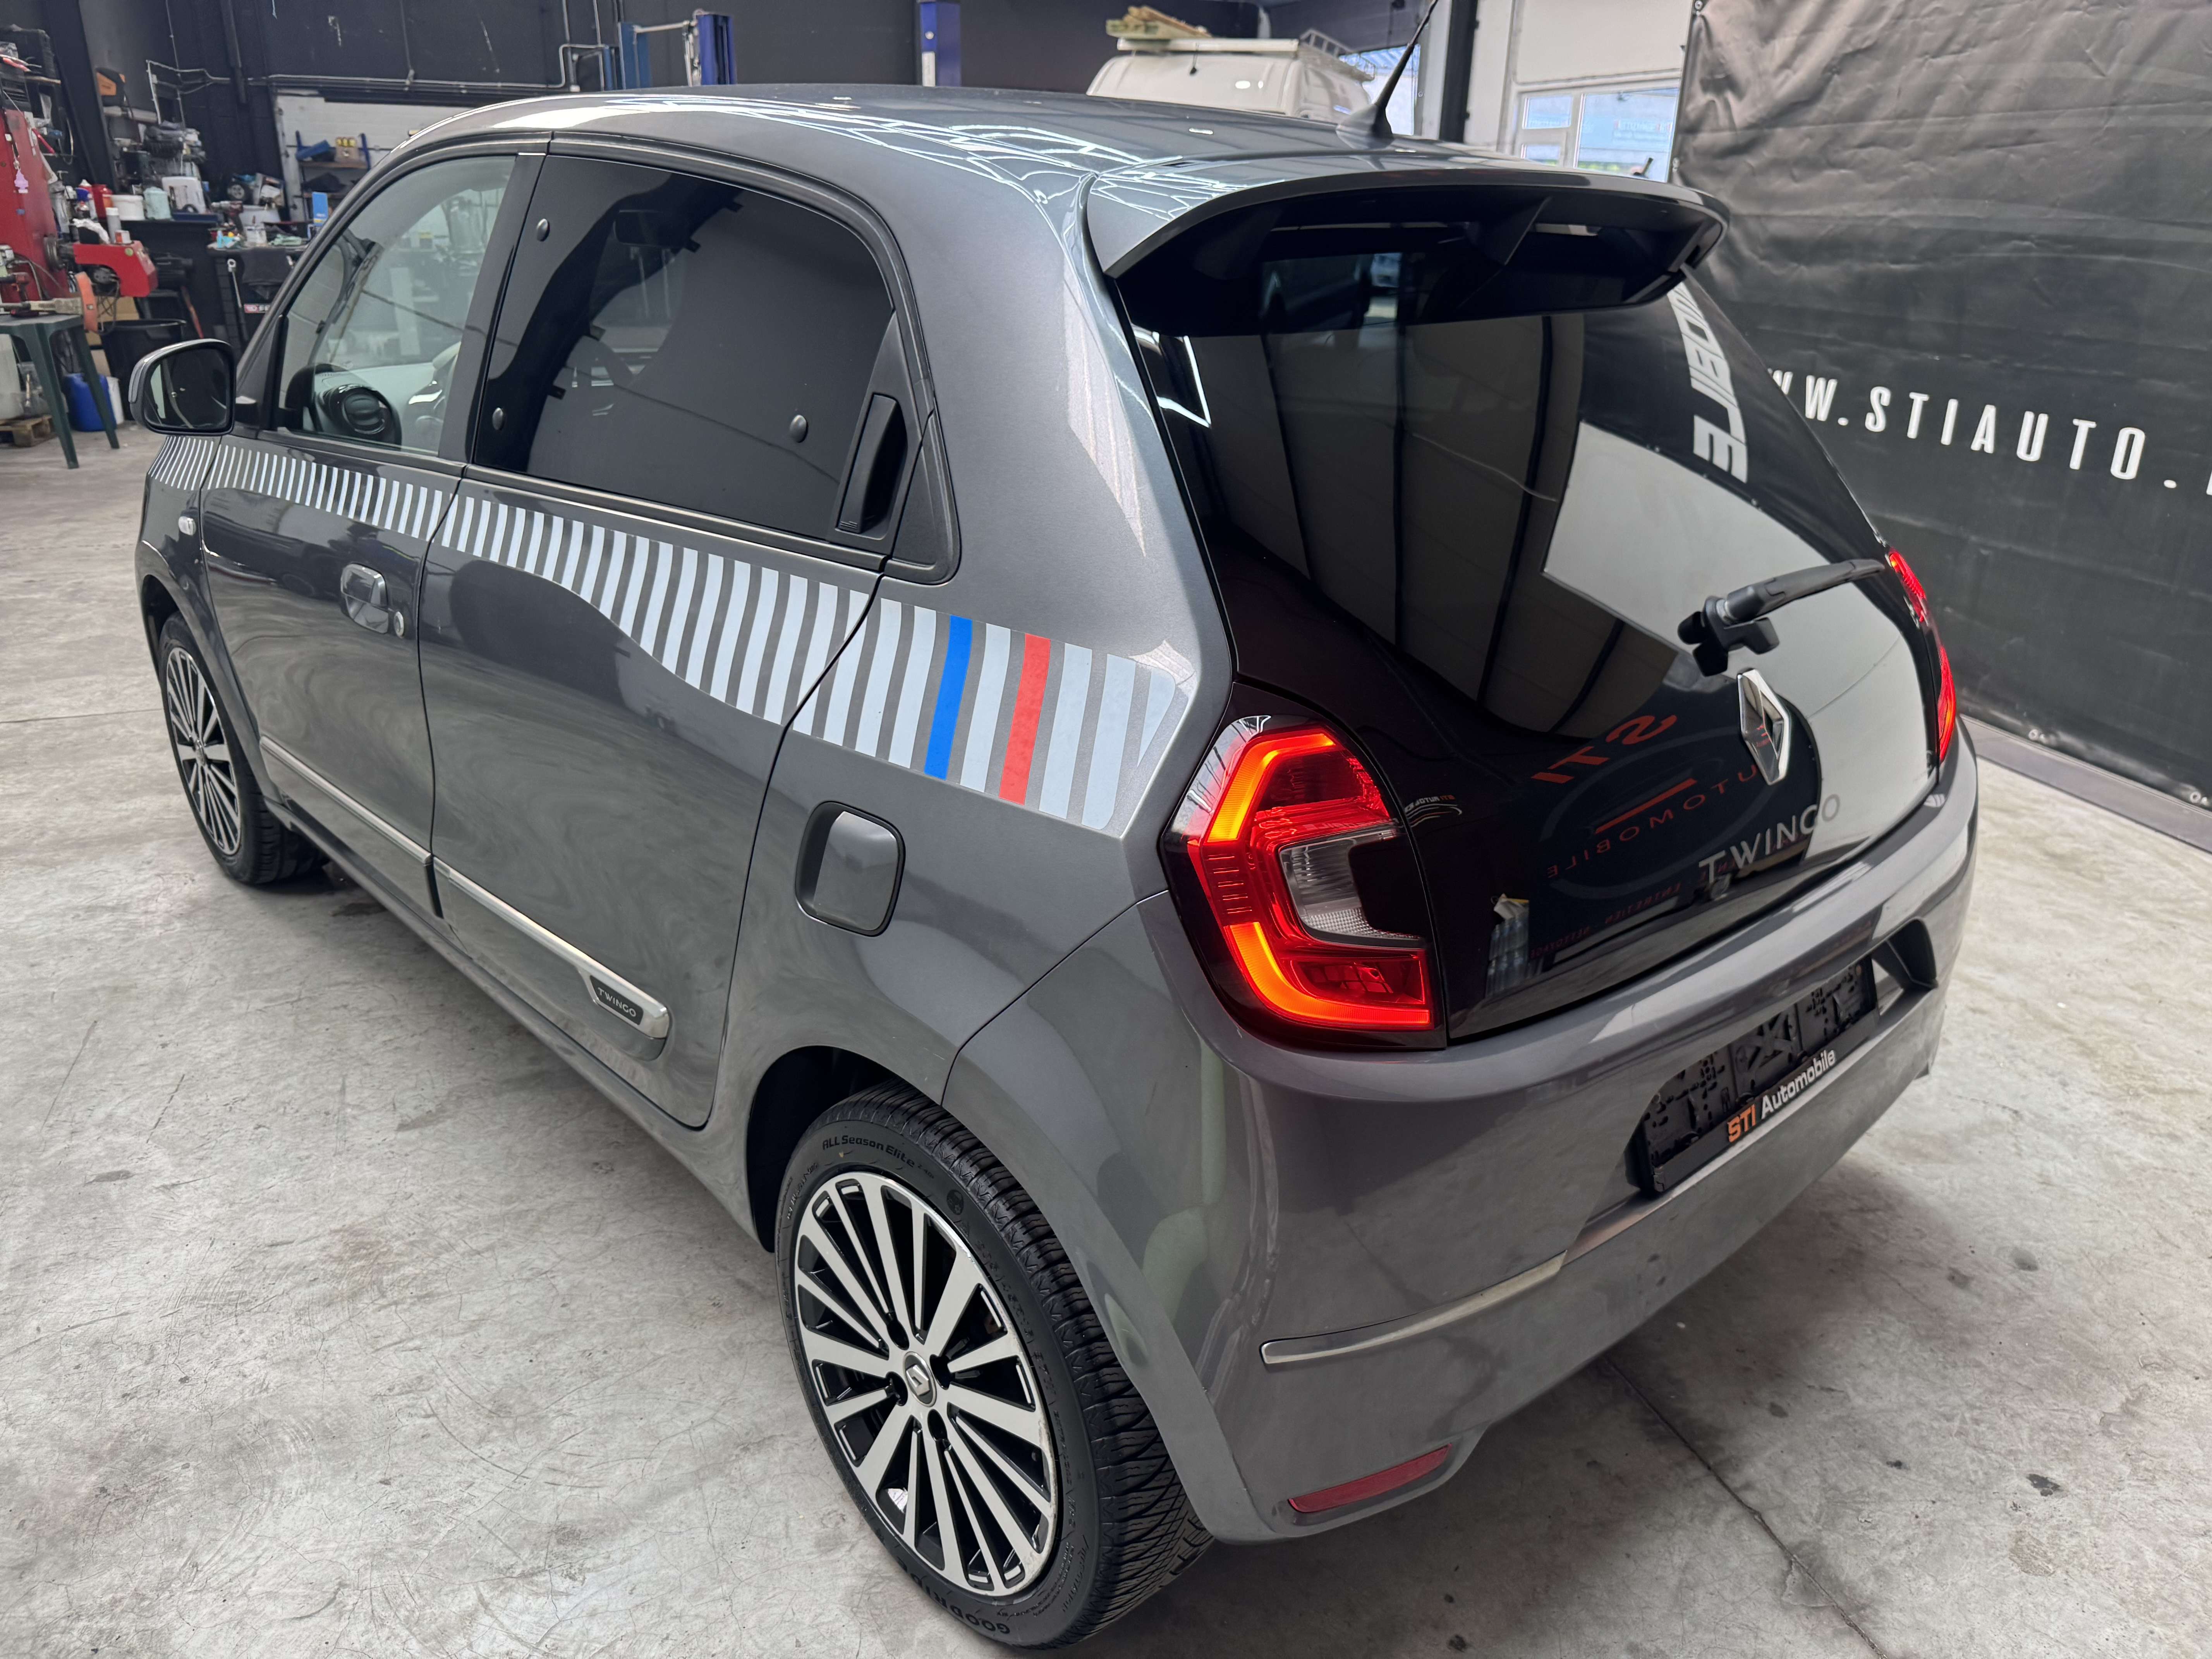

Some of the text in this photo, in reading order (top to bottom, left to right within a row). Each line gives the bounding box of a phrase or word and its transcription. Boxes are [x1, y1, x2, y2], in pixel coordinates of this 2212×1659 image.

[1767, 368, 2212, 495] W.STIAUTO.
[1698, 793, 1841, 884] TWINGO
[598, 987, 636, 1017] TWINGO
[1727, 1049, 1836, 1143] STI Automobile
[822, 1136, 840, 1150] ALL
[842, 1135, 884, 1151] Season
[886, 1144, 915, 1168] Elite
